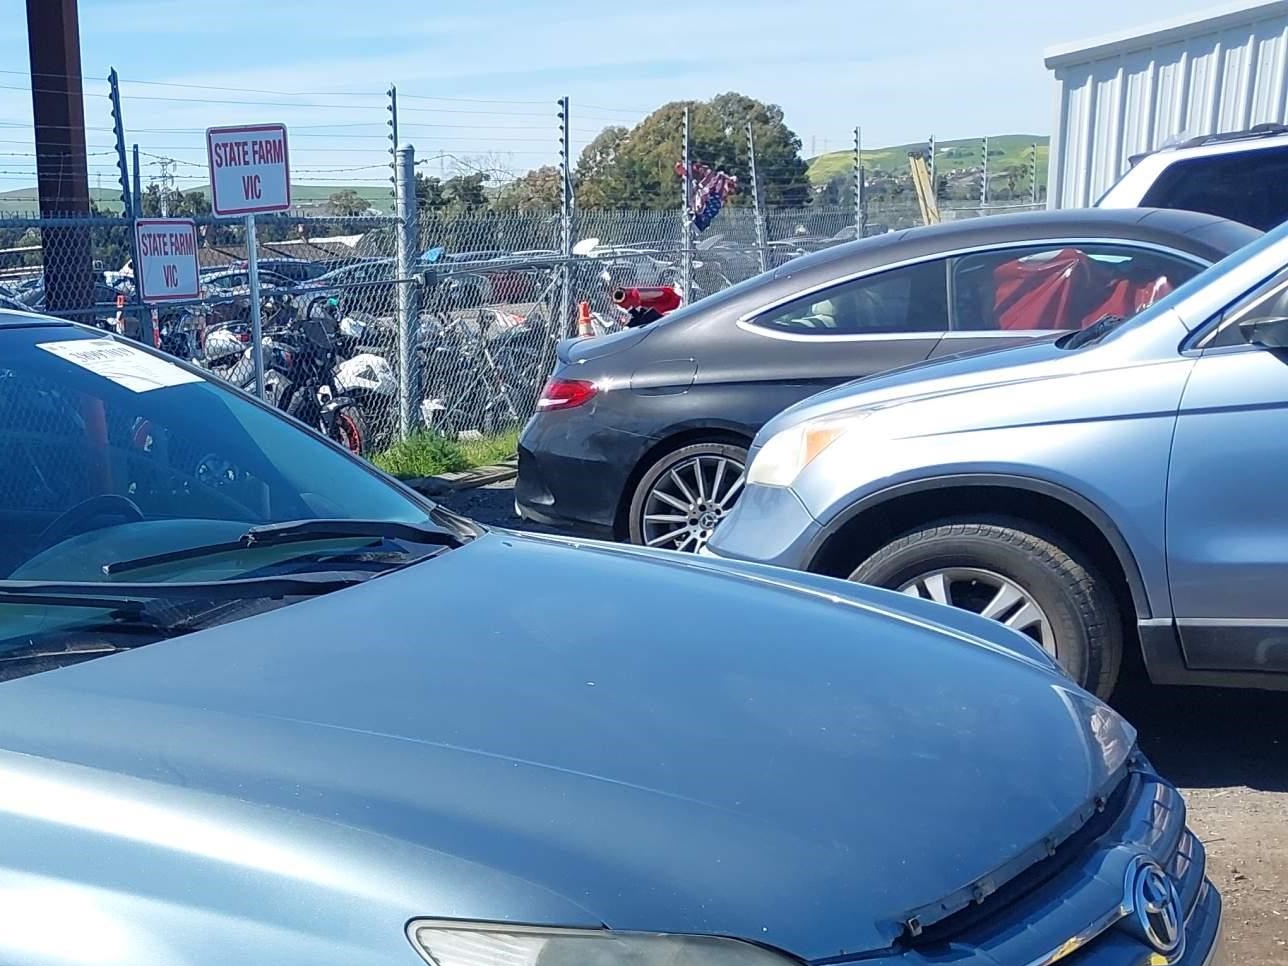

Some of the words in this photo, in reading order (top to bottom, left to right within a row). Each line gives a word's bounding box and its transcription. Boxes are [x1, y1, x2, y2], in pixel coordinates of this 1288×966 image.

[214, 141, 250, 168] STATE
[252, 139, 284, 166] FARM
[241, 174, 262, 201] VIC
[141, 233, 169, 257] STATE
[169, 232, 194, 256] FARM
[162, 264, 179, 288] VIC
